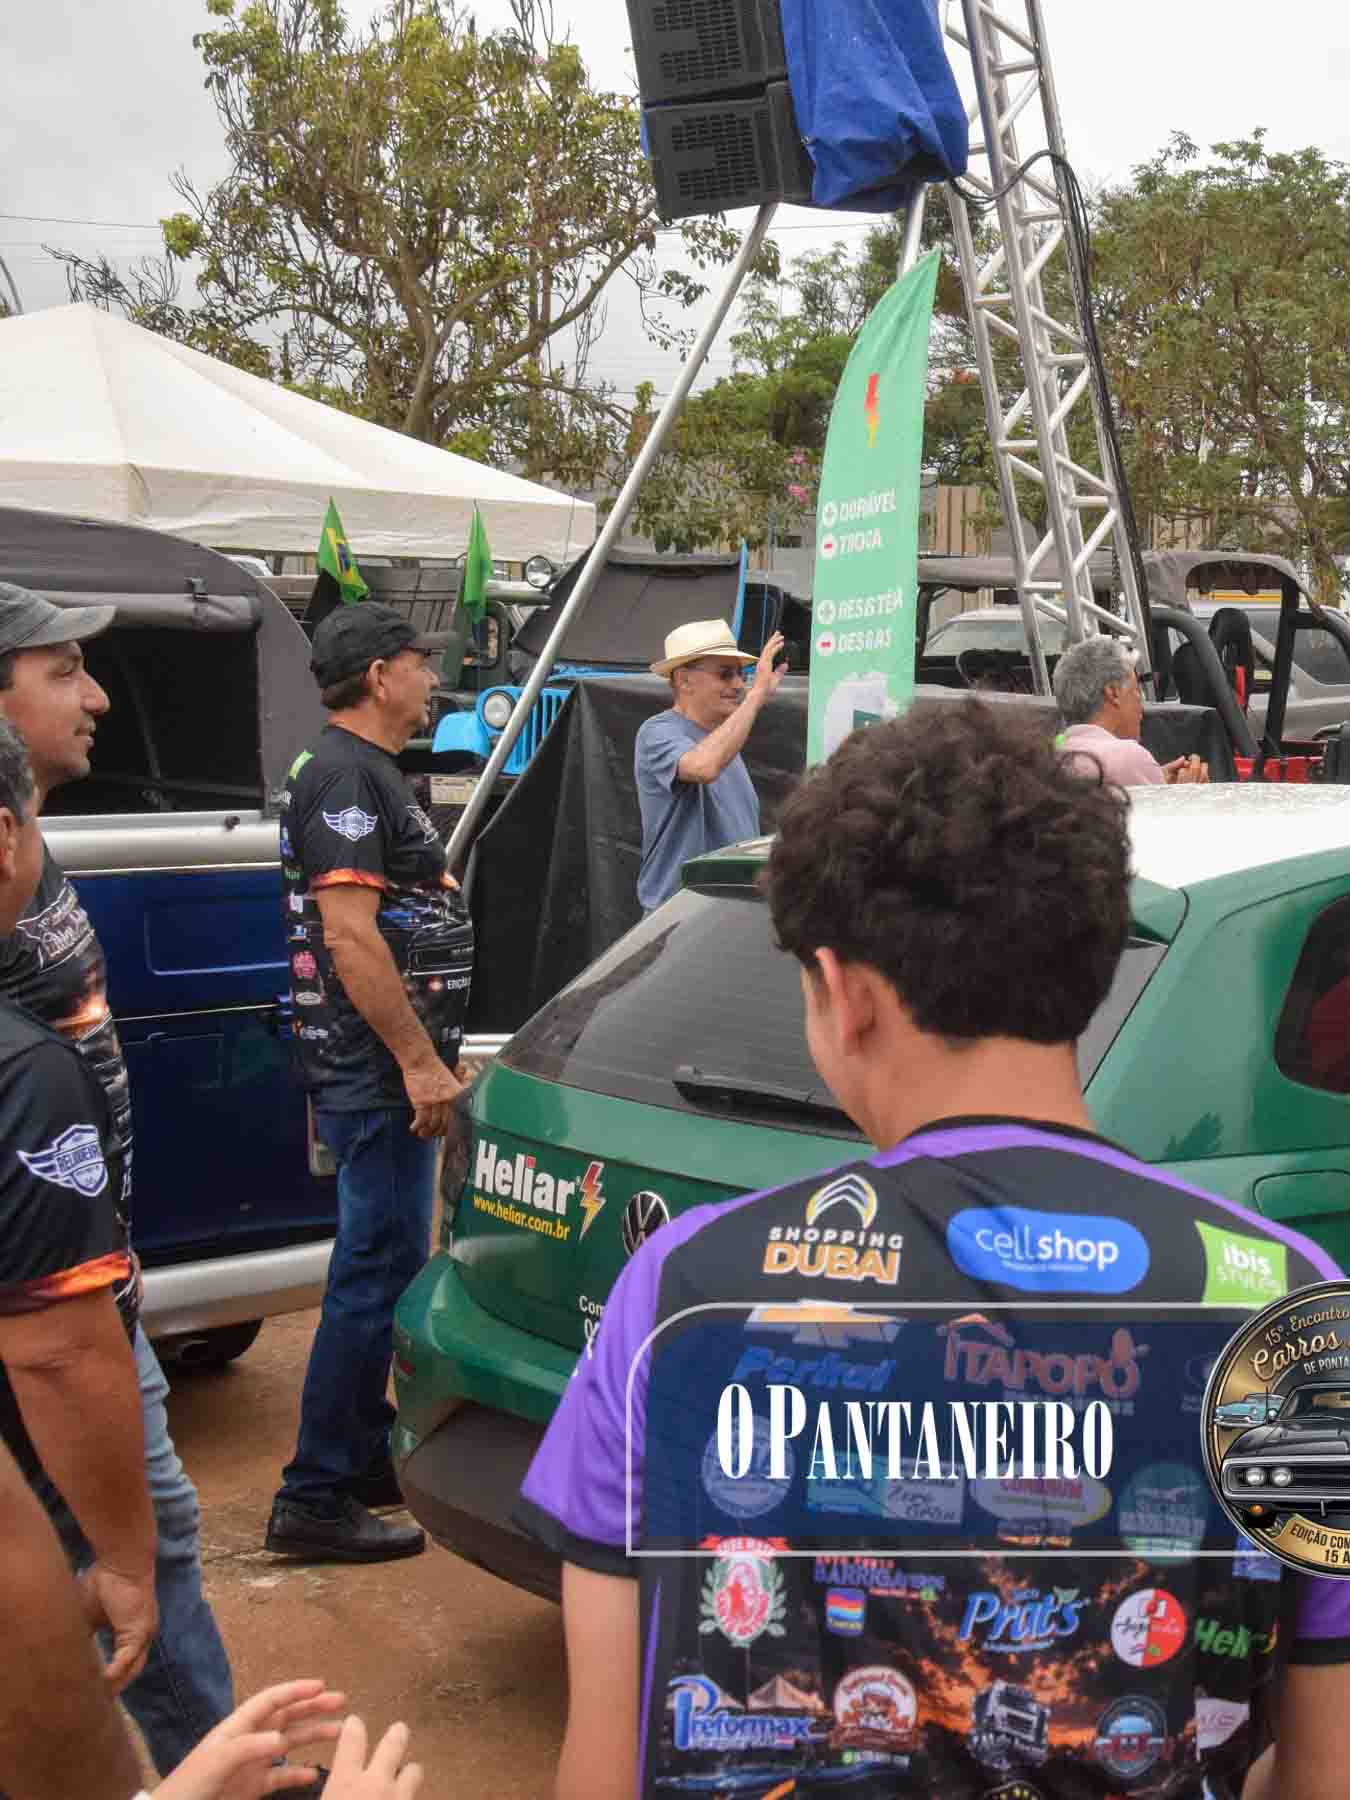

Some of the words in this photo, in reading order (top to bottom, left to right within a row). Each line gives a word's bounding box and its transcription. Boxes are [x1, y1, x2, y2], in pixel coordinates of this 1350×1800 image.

[474, 1139, 577, 1216] Heliar
[473, 1193, 571, 1241] www.heliar.com.br
[768, 1226, 904, 1250] SHOPPING
[763, 1242, 902, 1285] DUBAI
[1223, 1239, 1273, 1277] ibis
